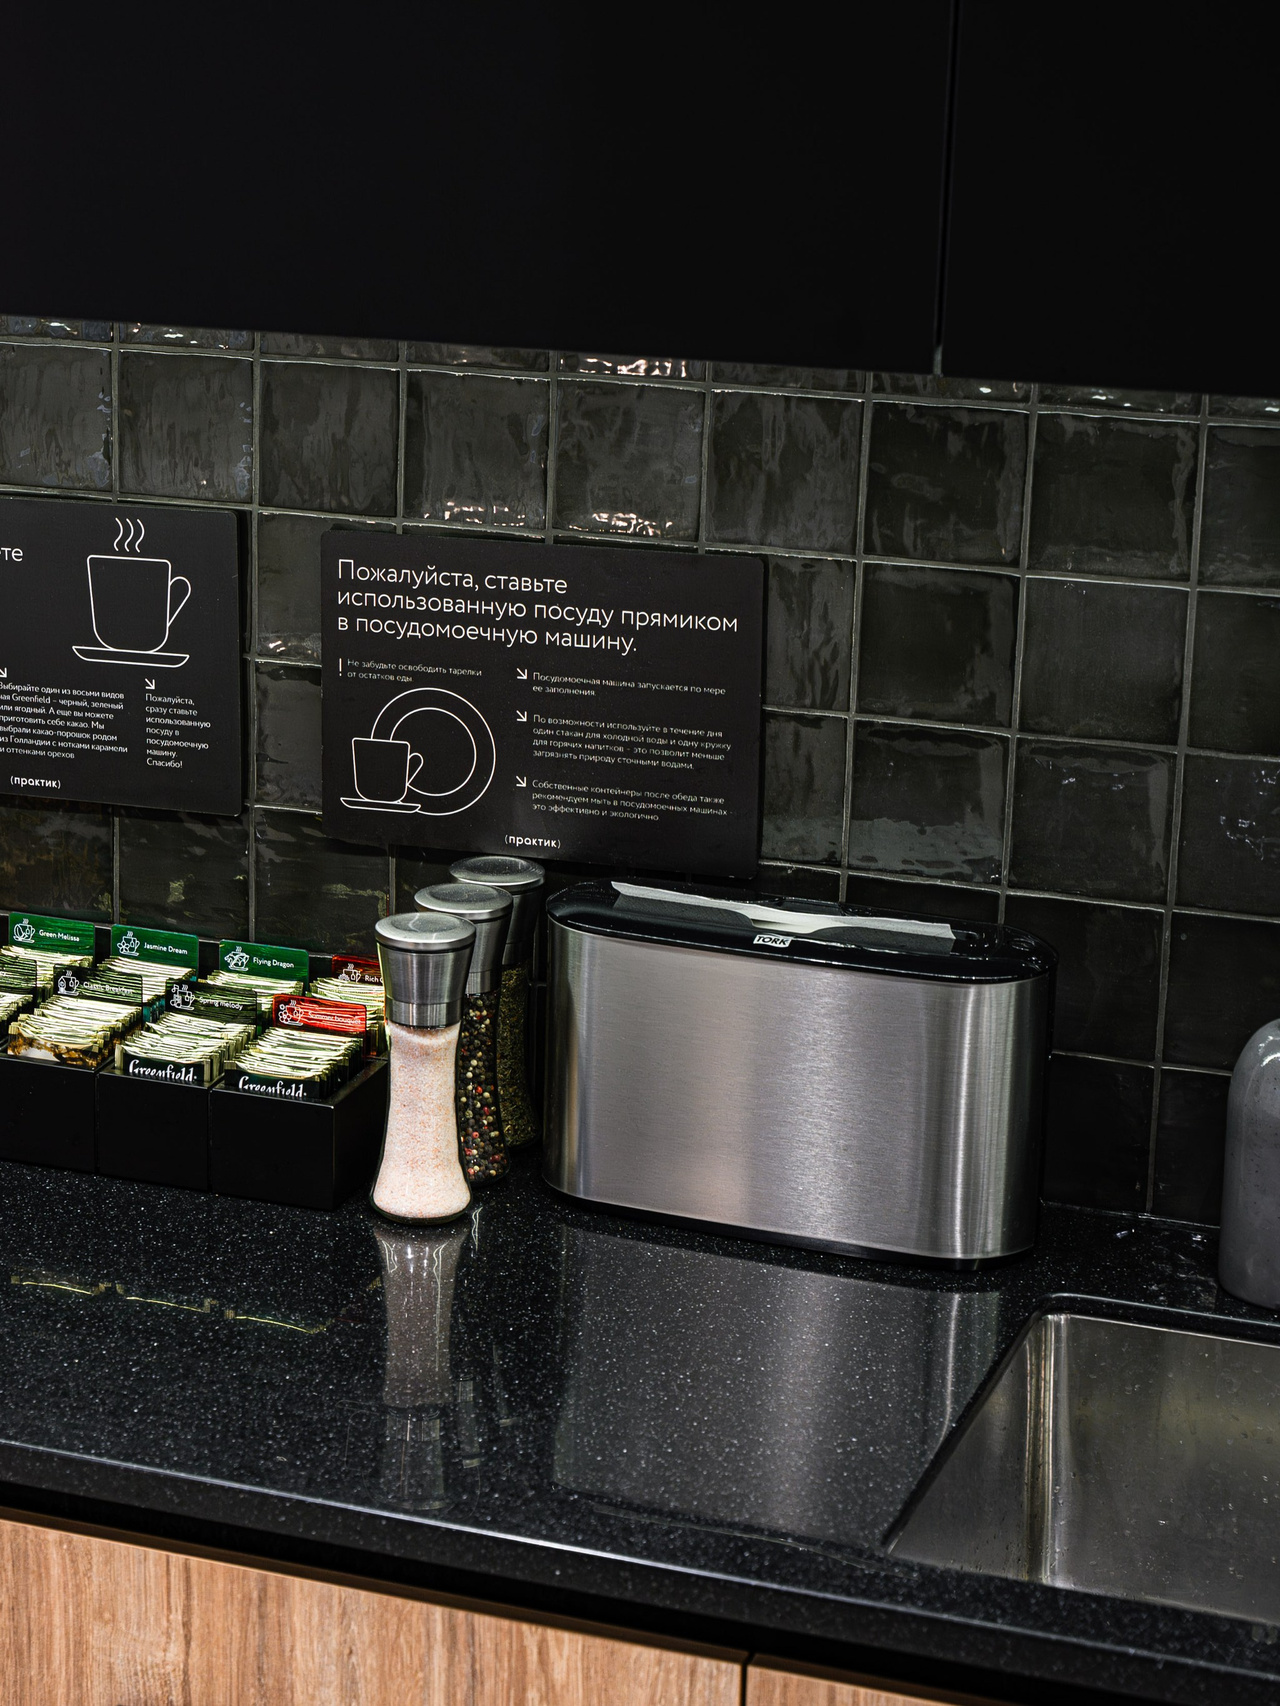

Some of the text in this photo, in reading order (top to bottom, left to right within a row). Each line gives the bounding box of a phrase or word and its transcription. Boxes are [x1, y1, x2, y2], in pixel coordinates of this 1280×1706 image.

[339, 559, 567, 594] Пожалуйста, ставьте
[338, 591, 737, 632] использованную посуду прямиком
[338, 617, 636, 656] в посудомоечную машину.
[347, 658, 482, 676] Не забудьте освободить тарелки
[358, 672, 395, 681] остатков
[533, 672, 600, 685] Посудомоечная
[602, 680, 635, 689] машина
[638, 682, 688, 692] запускается
[704, 687, 726, 695] мере
[12, 693, 50, 704] Greenfield
[59, 699, 89, 708] черный,
[146, 693, 194, 706] Пожалуйста,
[146, 706, 198, 716] сразу ставьте
[0, 715, 46, 724] приготовить
[47, 718, 65, 726] себе
[91, 721, 104, 729] Мы
[146, 717, 211, 729] использованную
[534, 714, 546, 724] По
[548, 718, 605, 728] возможности
[607, 723, 661, 733] используйте
[670, 728, 705, 736] течение
[0, 725, 31, 734] выбрали
[32, 729, 91, 739] какао-порошок
[146, 728, 173, 737] посуду
[10, 735, 50, 746] Голландии
[91, 744, 128, 752] карамели
[146, 738, 209, 750] посудомоечную
[533, 728, 554, 736] один
[603, 734, 644, 742] холодной
[646, 737, 668, 745] воды
[678, 740, 699, 749] одну
[700, 742, 731, 751] кружку
[6, 748, 45, 756] оттенками
[550, 740, 582, 748] горячих
[584, 744, 624, 752] напитков
[649, 749, 689, 757] позволит
[692, 752, 725, 760] меньше
[146, 758, 182, 768] Спасибо!
[533, 750, 577, 759] загрязнять
[579, 754, 616, 764] природу
[617, 757, 659, 766] сточными
[10, 776, 60, 789] (практик)
[532, 779, 589, 792] Собственные
[591, 787, 642, 798] контейнеры
[672, 793, 697, 802] обеда
[700, 796, 724, 804] также
[532, 793, 588, 804] рекомендуем
[620, 800, 687, 812] посудомоечных
[690, 807, 727, 816] машинах
[532, 804, 600, 816] это эффективно
[505, 835, 560, 848] (практик)
[39, 929, 80, 942] Green Melissa
[756, 935, 789, 946] TORK
[143, 942, 188, 955] Jasmine Dream
[252, 957, 295, 969] Flying Dragon
[364, 974, 379, 983] Rich
[83, 981, 105, 991] Classic
[198, 995, 243, 1011] Spring melody
